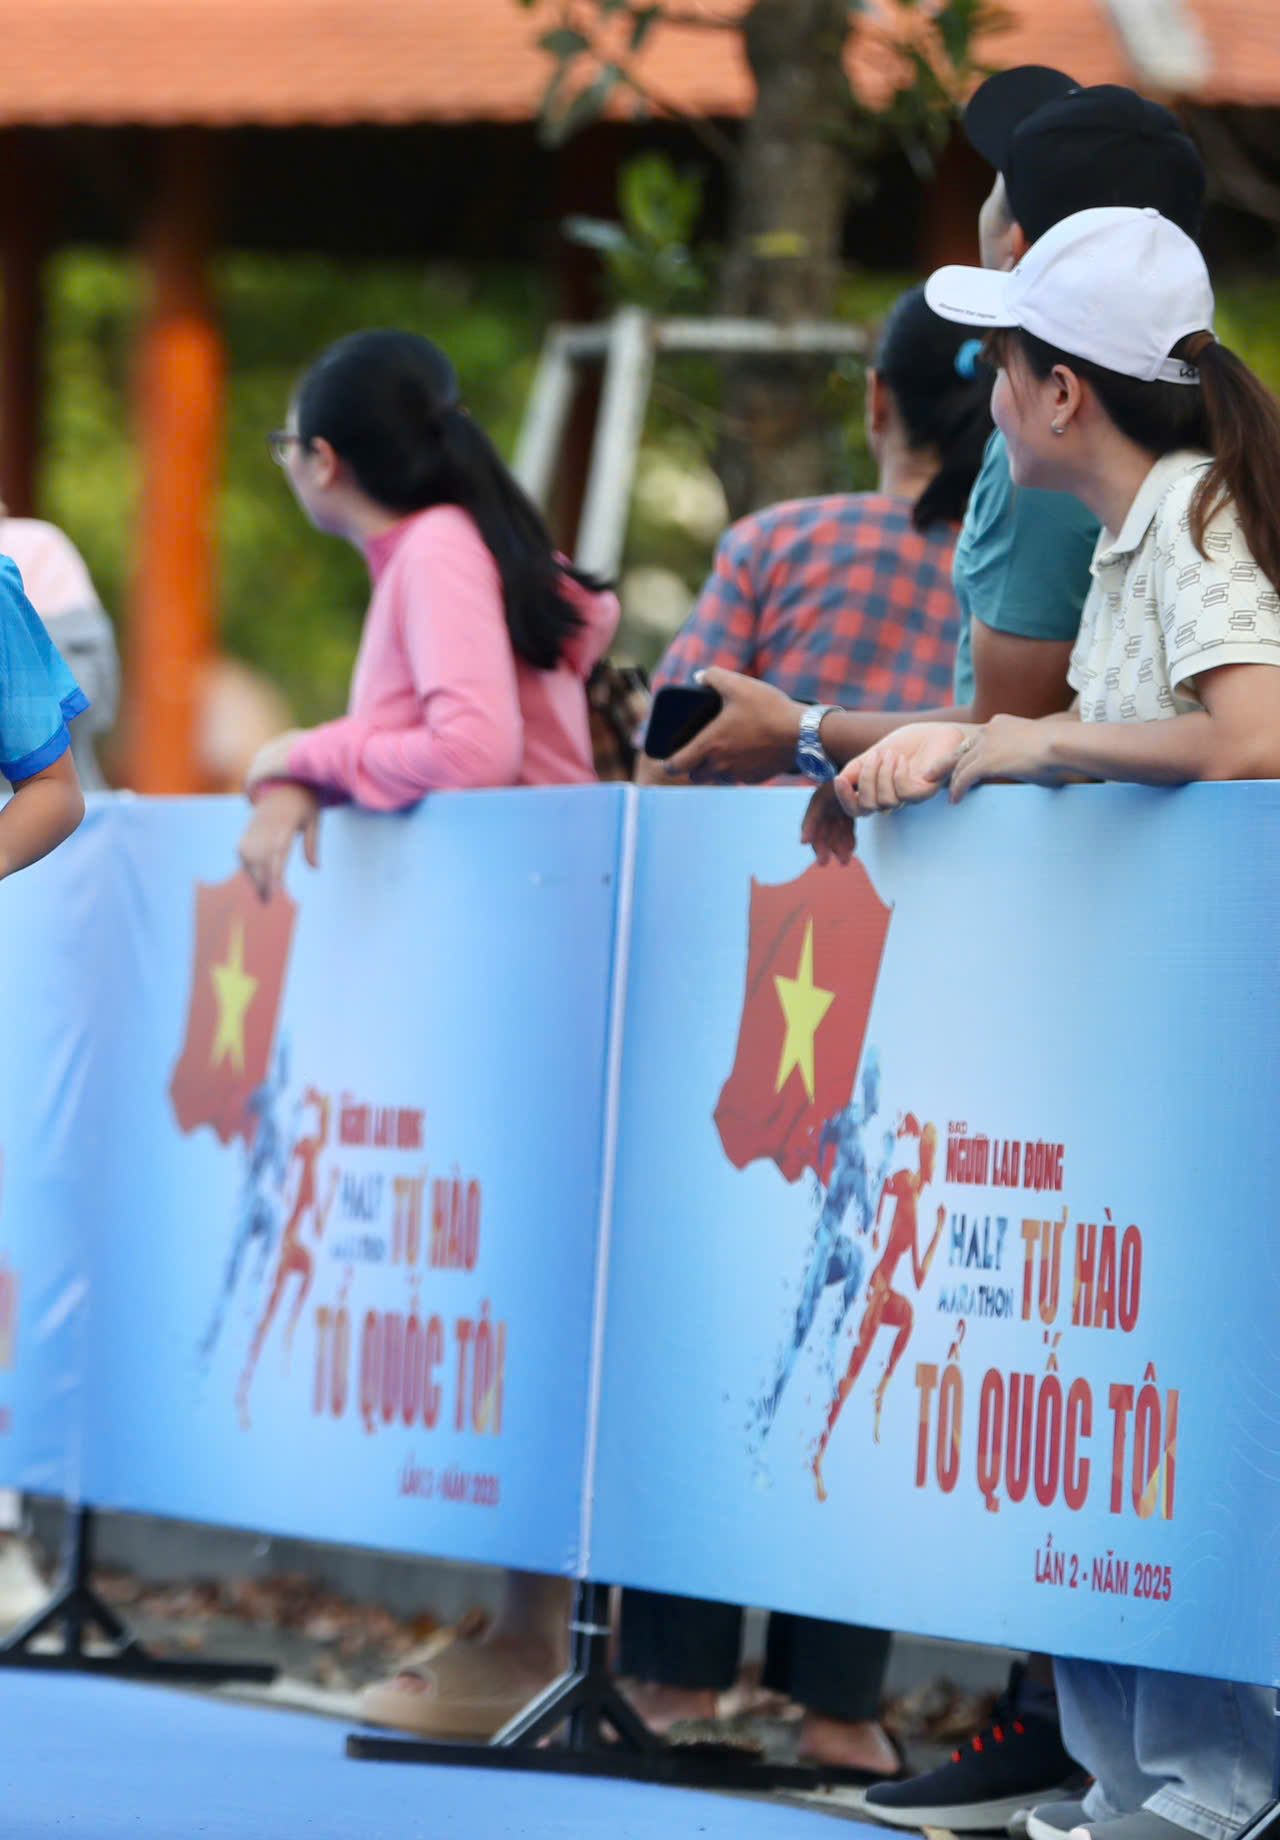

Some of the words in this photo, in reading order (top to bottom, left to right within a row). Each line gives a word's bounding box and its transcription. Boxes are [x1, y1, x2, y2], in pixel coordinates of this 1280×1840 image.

[992, 1139, 1021, 1189] LAO
[1071, 1207, 1143, 1333] HÀO
[914, 1318, 967, 1493] TỔ
[975, 1332, 1094, 1513] QUỐC
[1108, 1361, 1181, 1521] TÔI
[1070, 1552, 1080, 1589] 2
[1091, 1549, 1130, 1596] NĂM
[1133, 1562, 1174, 1602] 2025
